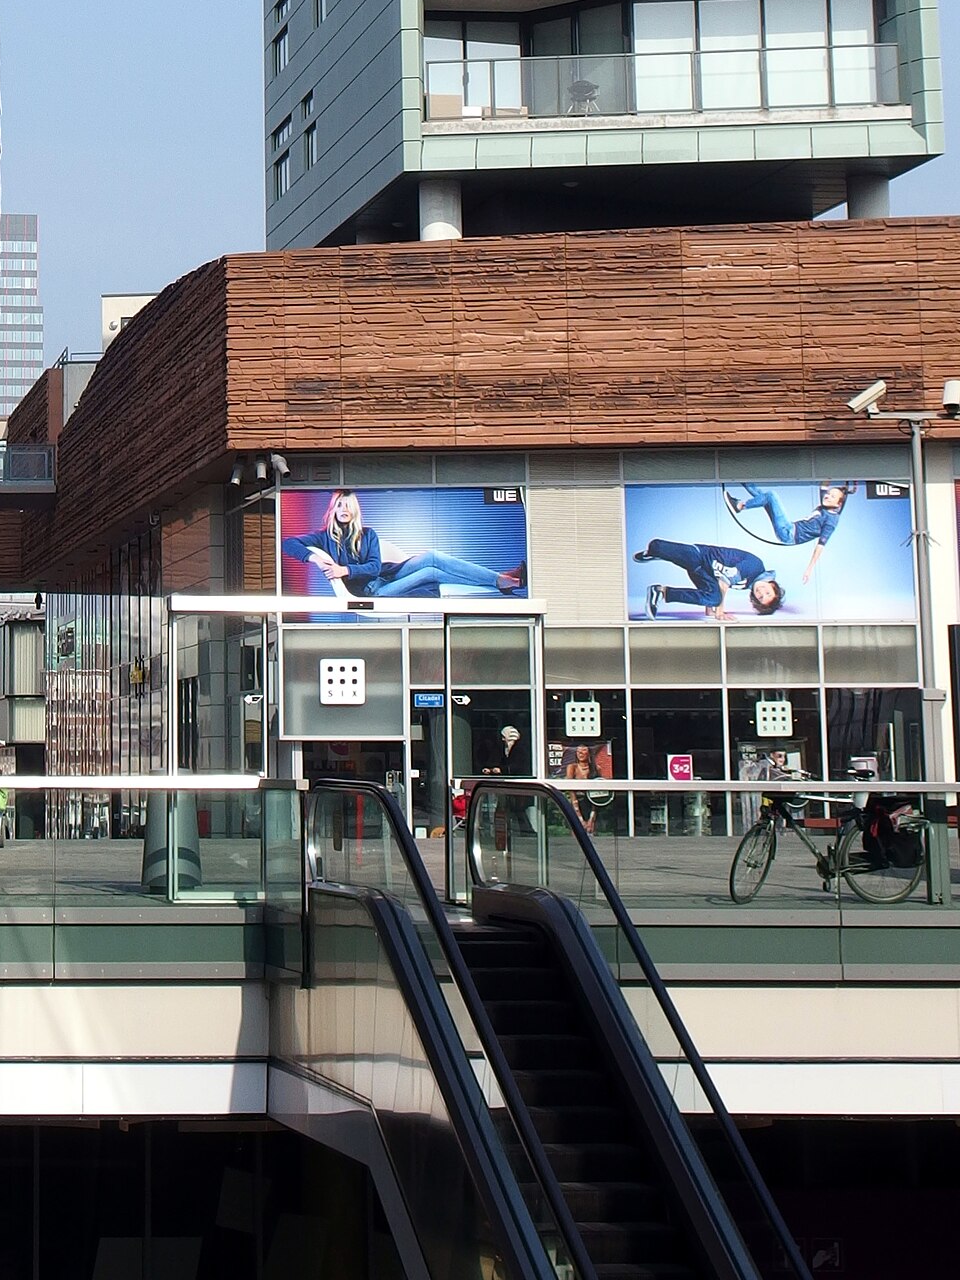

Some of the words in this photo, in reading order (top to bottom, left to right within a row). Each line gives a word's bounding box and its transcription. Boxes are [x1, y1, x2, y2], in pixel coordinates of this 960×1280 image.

[493, 490, 517, 502] WE
[876, 484, 901, 496] WE
[328, 690, 358, 698] SIX
